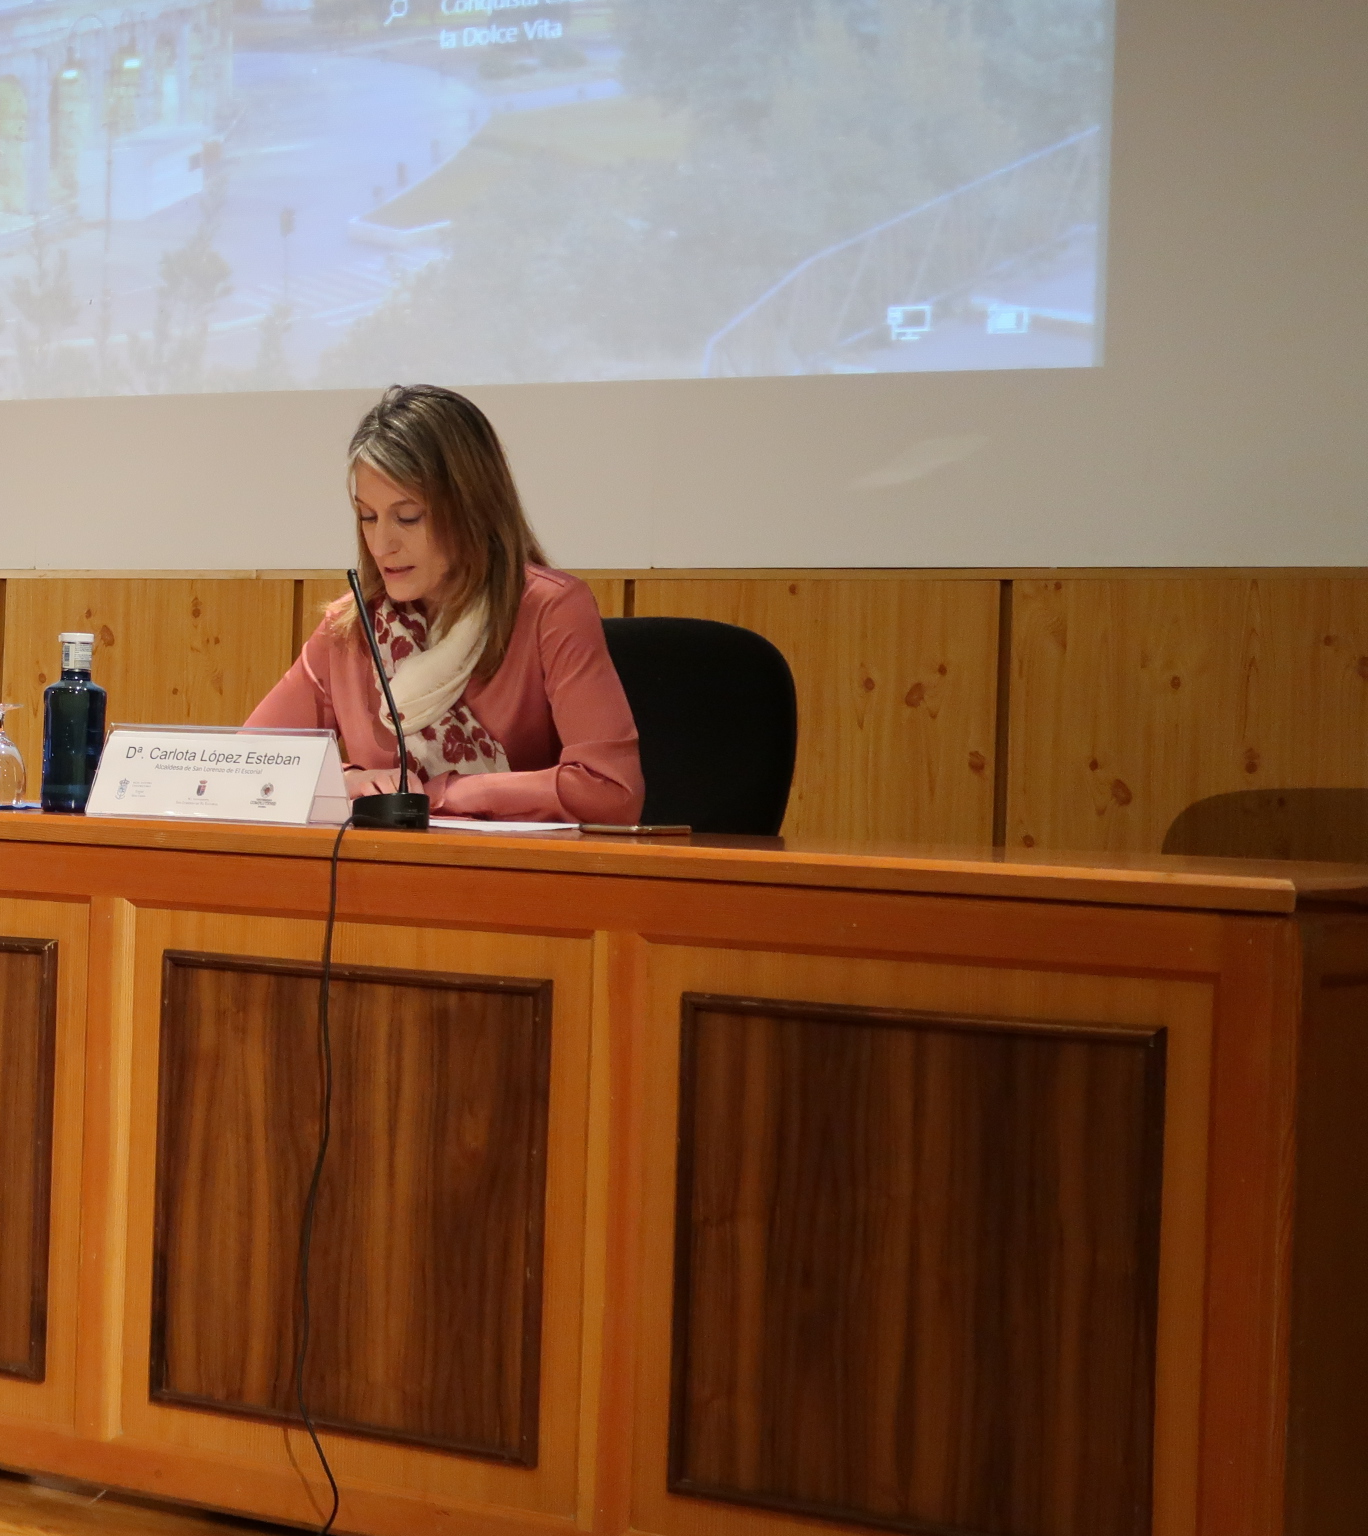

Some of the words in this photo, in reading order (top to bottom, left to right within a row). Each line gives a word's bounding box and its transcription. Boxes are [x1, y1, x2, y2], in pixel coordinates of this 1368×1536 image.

[463, 24, 518, 47] Dolce
[523, 18, 563, 40] Vita
[149, 747, 196, 761] Carlota
[200, 749, 242, 765] López
[245, 751, 301, 766] Esteban
[154, 763, 183, 771] Alcaldesa
